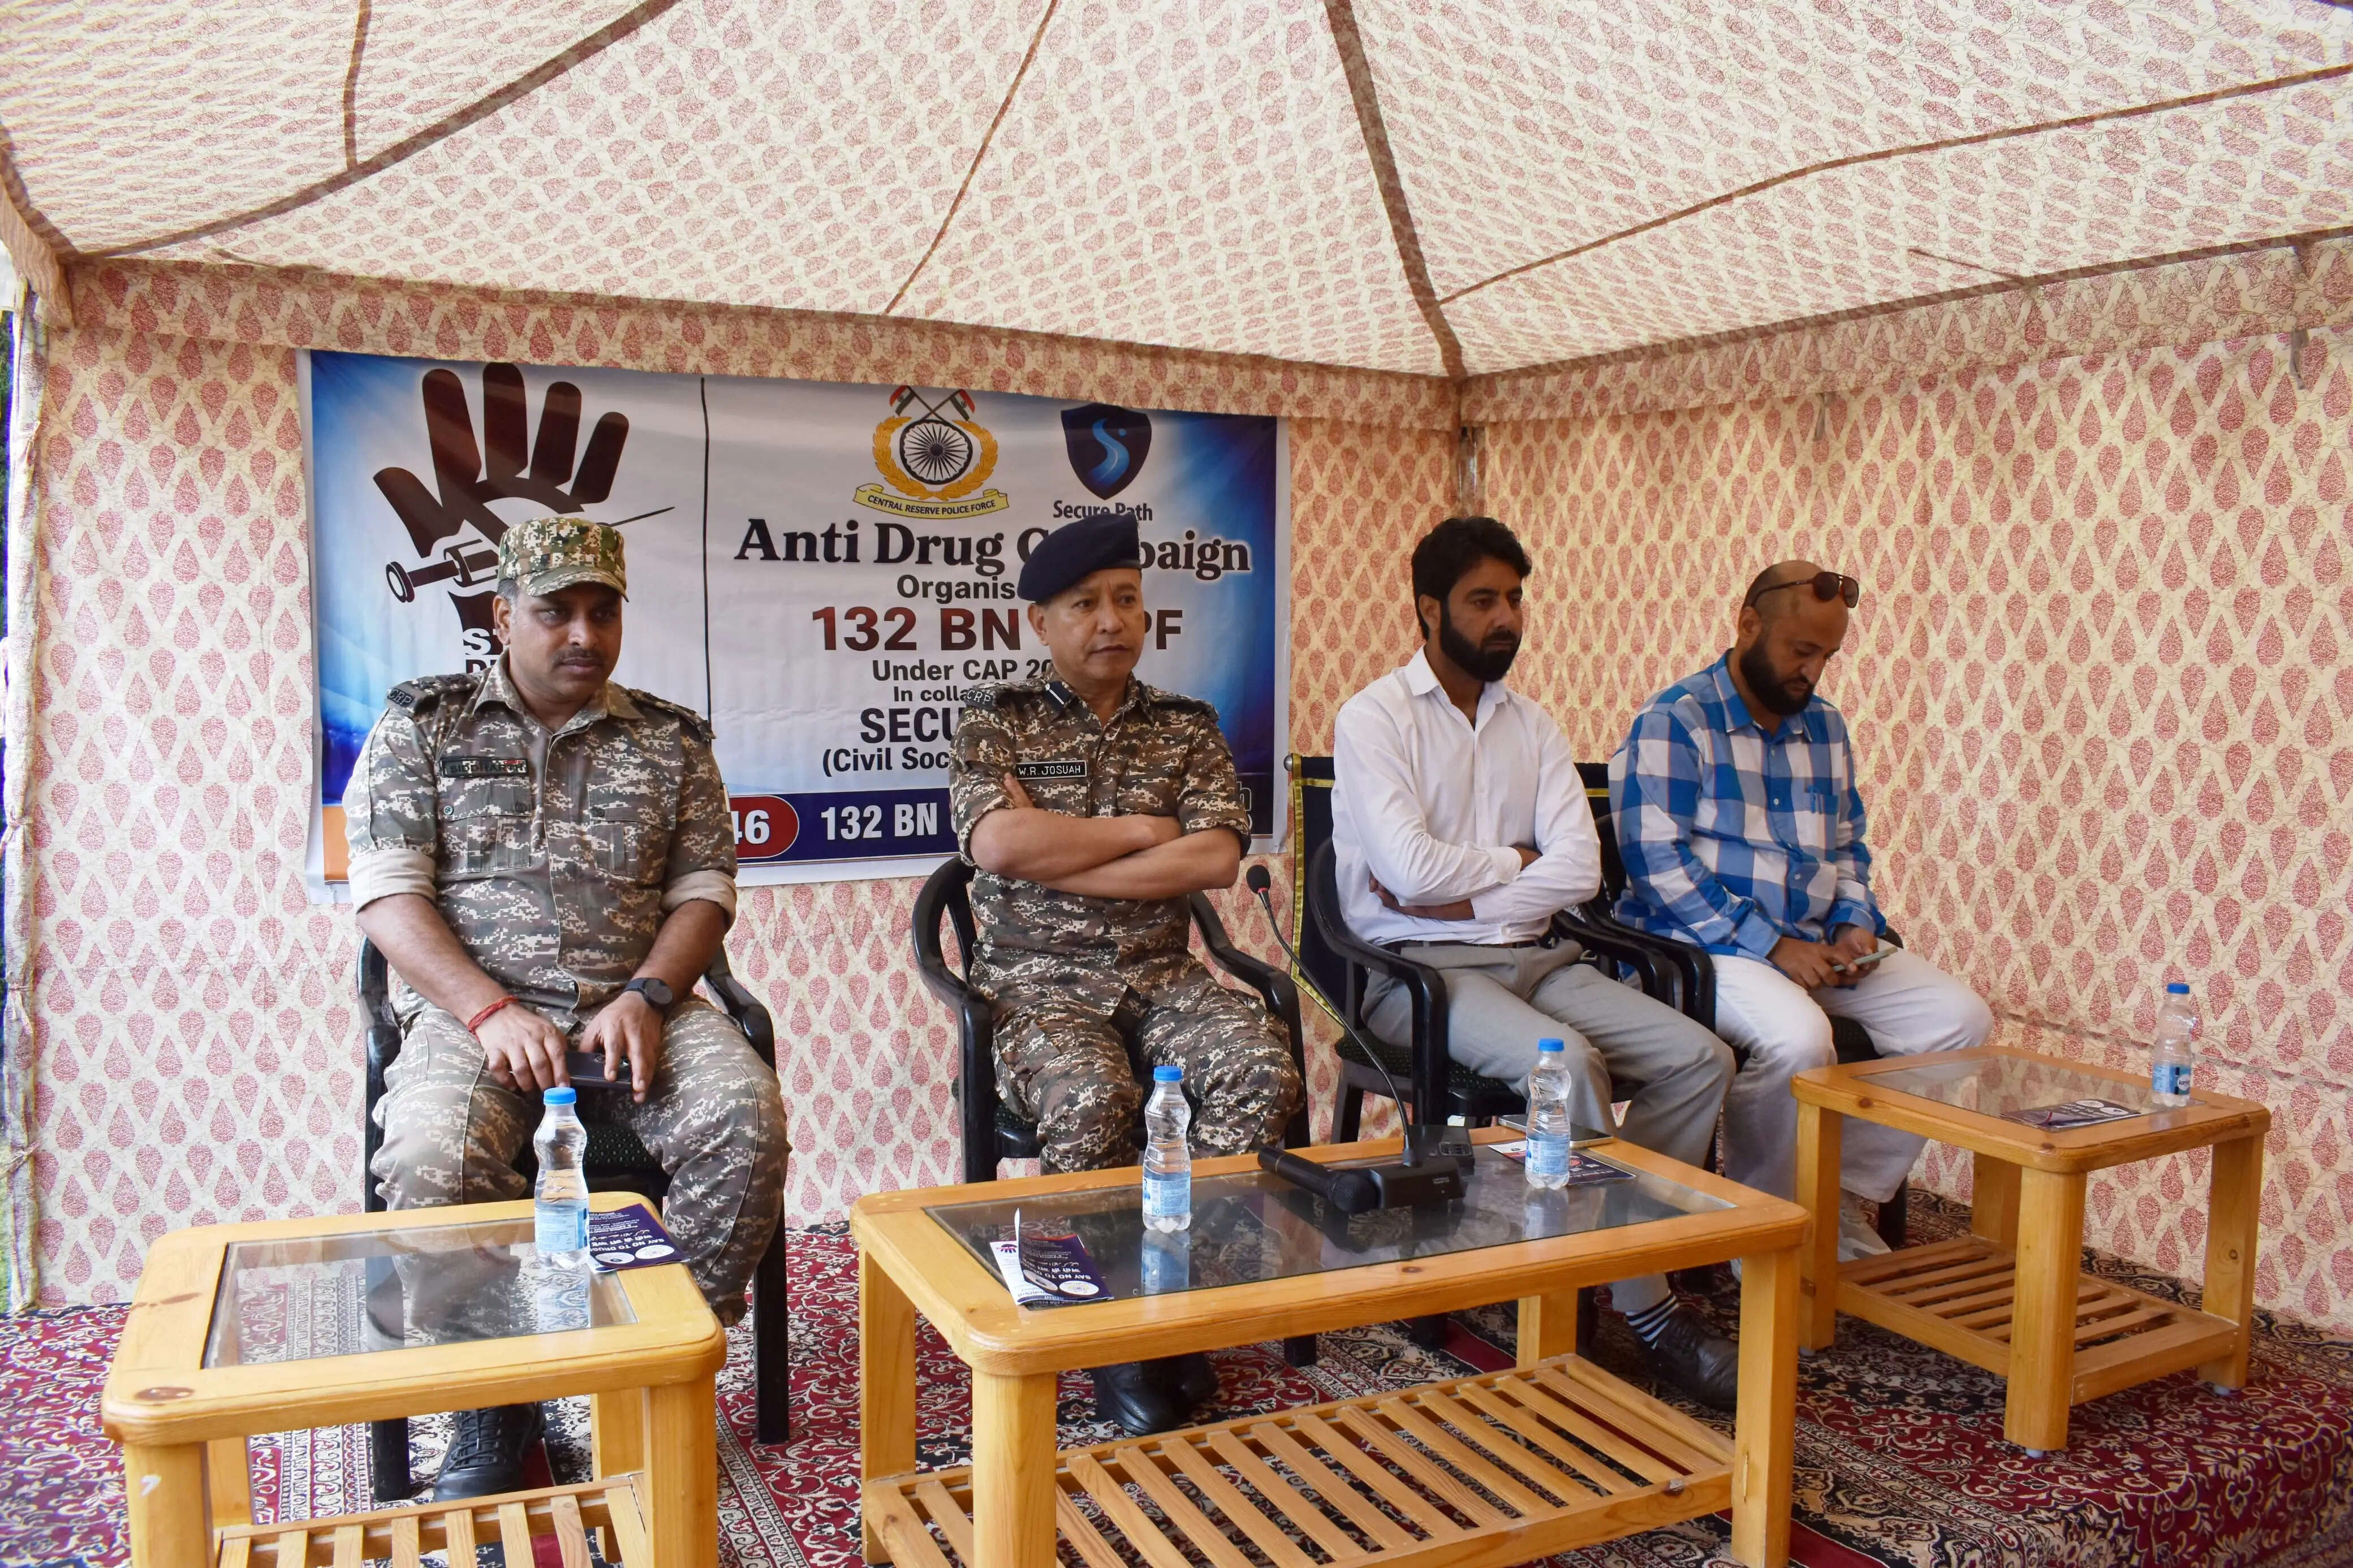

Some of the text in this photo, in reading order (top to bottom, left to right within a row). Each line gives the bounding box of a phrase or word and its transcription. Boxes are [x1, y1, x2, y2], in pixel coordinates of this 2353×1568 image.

[868, 495, 996, 515] CENTRAL RESERVE POLICE FORCE
[1053, 500, 1110, 519] Secure
[734, 519, 860, 563] Anti
[873, 522, 1005, 577] Drug
[897, 574, 1019, 604] Organis
[812, 606, 1022, 651] 132 BN
[872, 659, 954, 681] Under
[963, 659, 1018, 680] CAP
[389, 688, 412, 705] CRP
[894, 686, 913, 702] In
[967, 690, 991, 705] CRP
[860, 707, 964, 744] SECU
[822, 748, 892, 777] (Civil
[1041, 765, 1080, 775] JOSUAH
[821, 805, 882, 840] 132
[894, 802, 938, 837] BN
